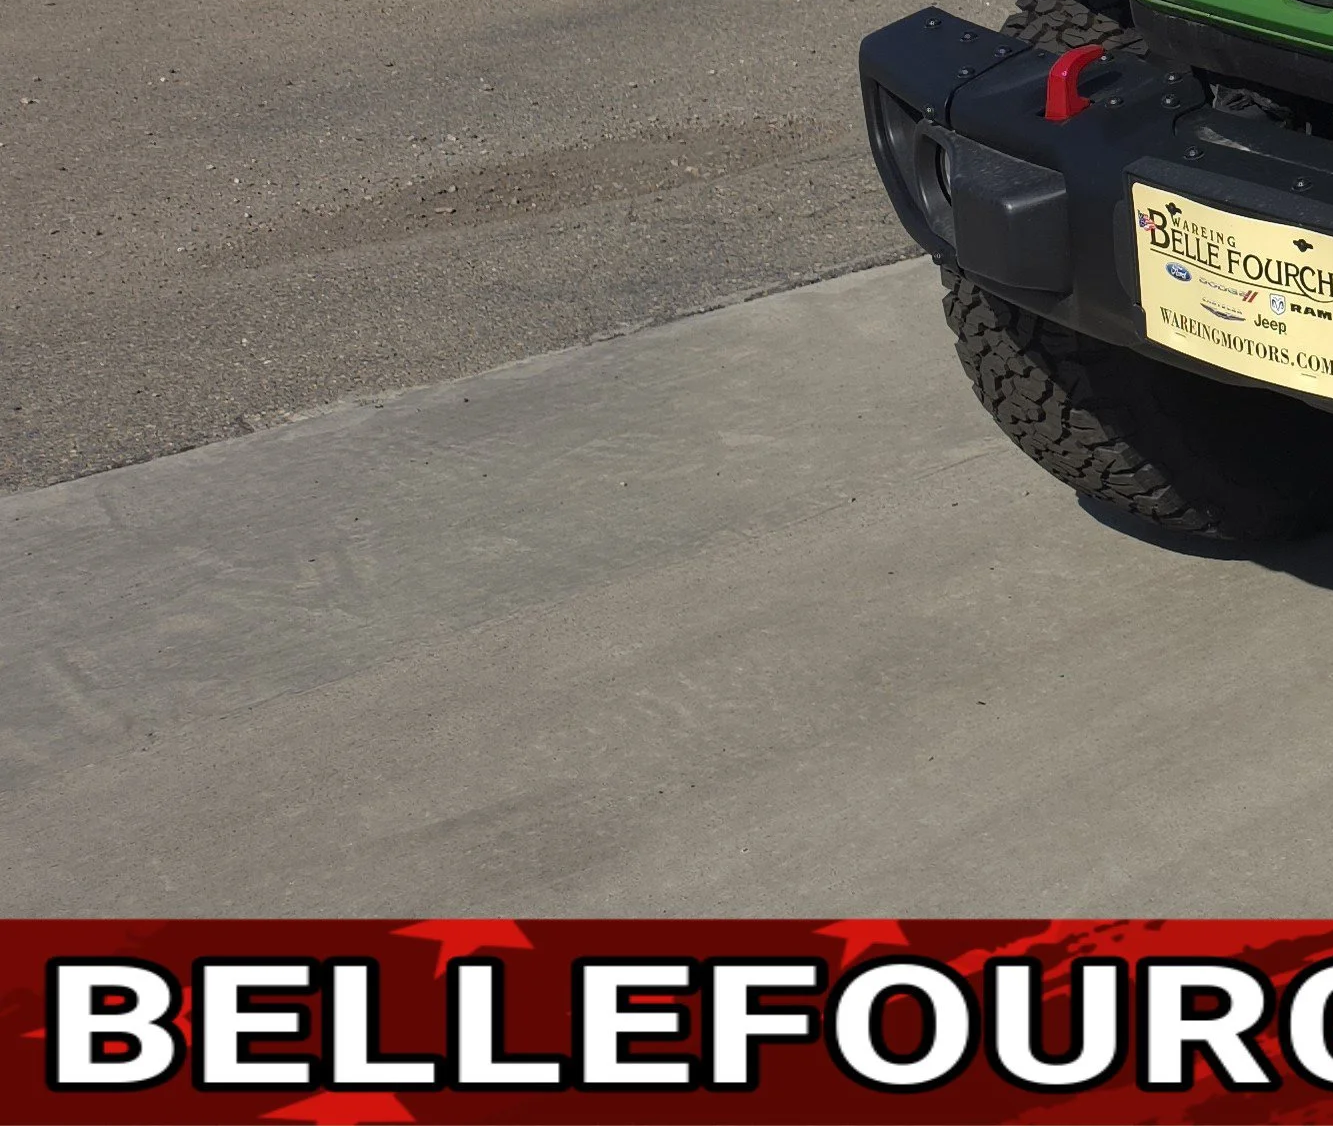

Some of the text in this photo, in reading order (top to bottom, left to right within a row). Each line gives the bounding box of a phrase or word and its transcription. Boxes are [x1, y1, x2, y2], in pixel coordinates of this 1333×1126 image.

[1147, 208, 1222, 271] BELLE
[1171, 216, 1237, 248] WAREING
[1253, 313, 1287, 335] Jeep
[1290, 302, 1333, 321] RAM
